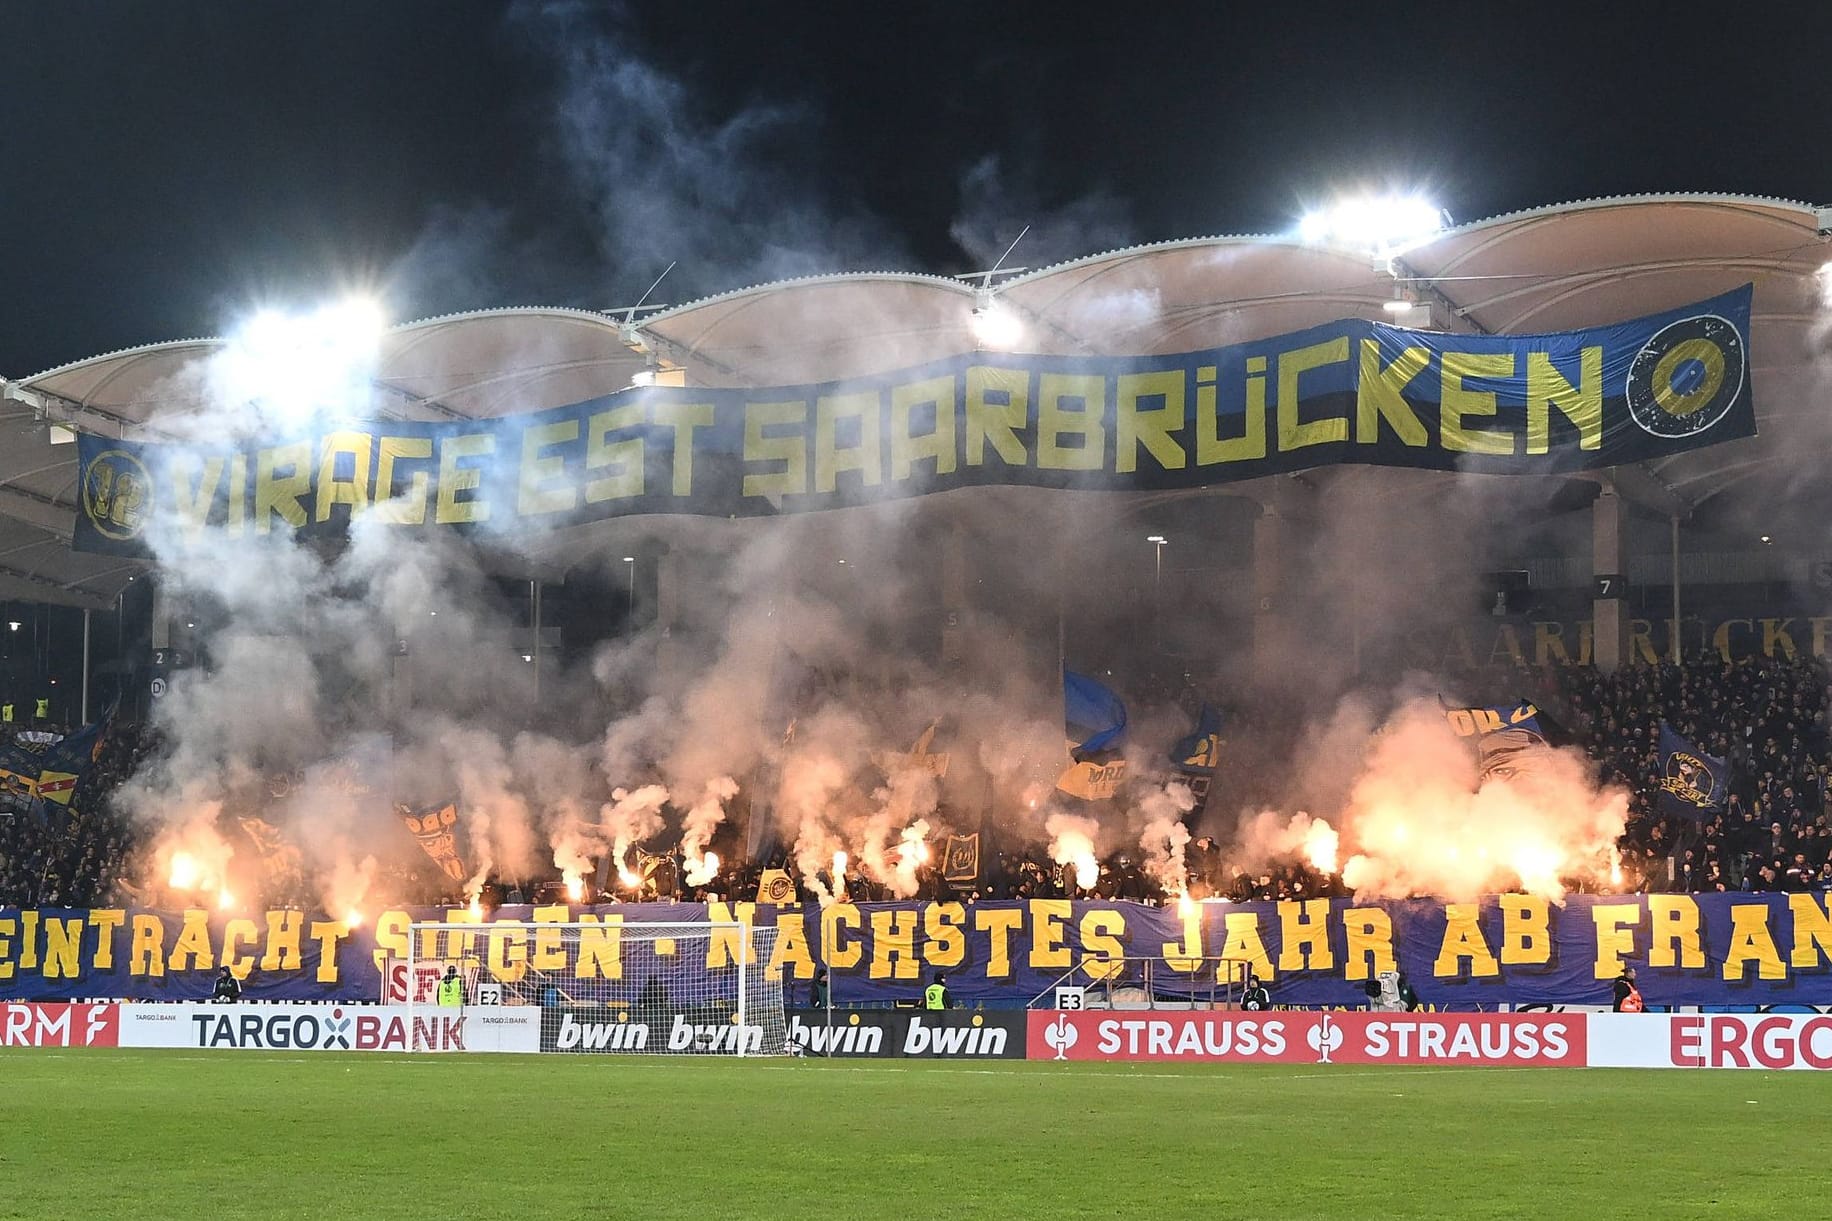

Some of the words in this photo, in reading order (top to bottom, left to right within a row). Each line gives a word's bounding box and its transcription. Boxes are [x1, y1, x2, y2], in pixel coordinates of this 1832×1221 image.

[170, 431, 496, 543] VIRAGE
[518, 403, 714, 516] EST
[742, 337, 1602, 497] SAARBRÜCKEN
[1600, 579, 1611, 595] 7
[155, 651, 164, 665] 2
[0, 908, 351, 983] EINTRACHT
[706, 899, 1126, 981] NÄCHSTES
[1162, 899, 1398, 985] JAHR
[1433, 892, 1551, 977] AB
[480, 990, 499, 1005] E2
[1059, 993, 1082, 1010] E3
[0, 1005, 72, 1048] RM
[556, 1011, 649, 1050] bwin
[790, 1013, 883, 1053] bwin
[903, 1014, 1008, 1054] bwin
[1097, 1019, 1287, 1057] STRAUSS
[1364, 1020, 1569, 1060] STRAUSS
